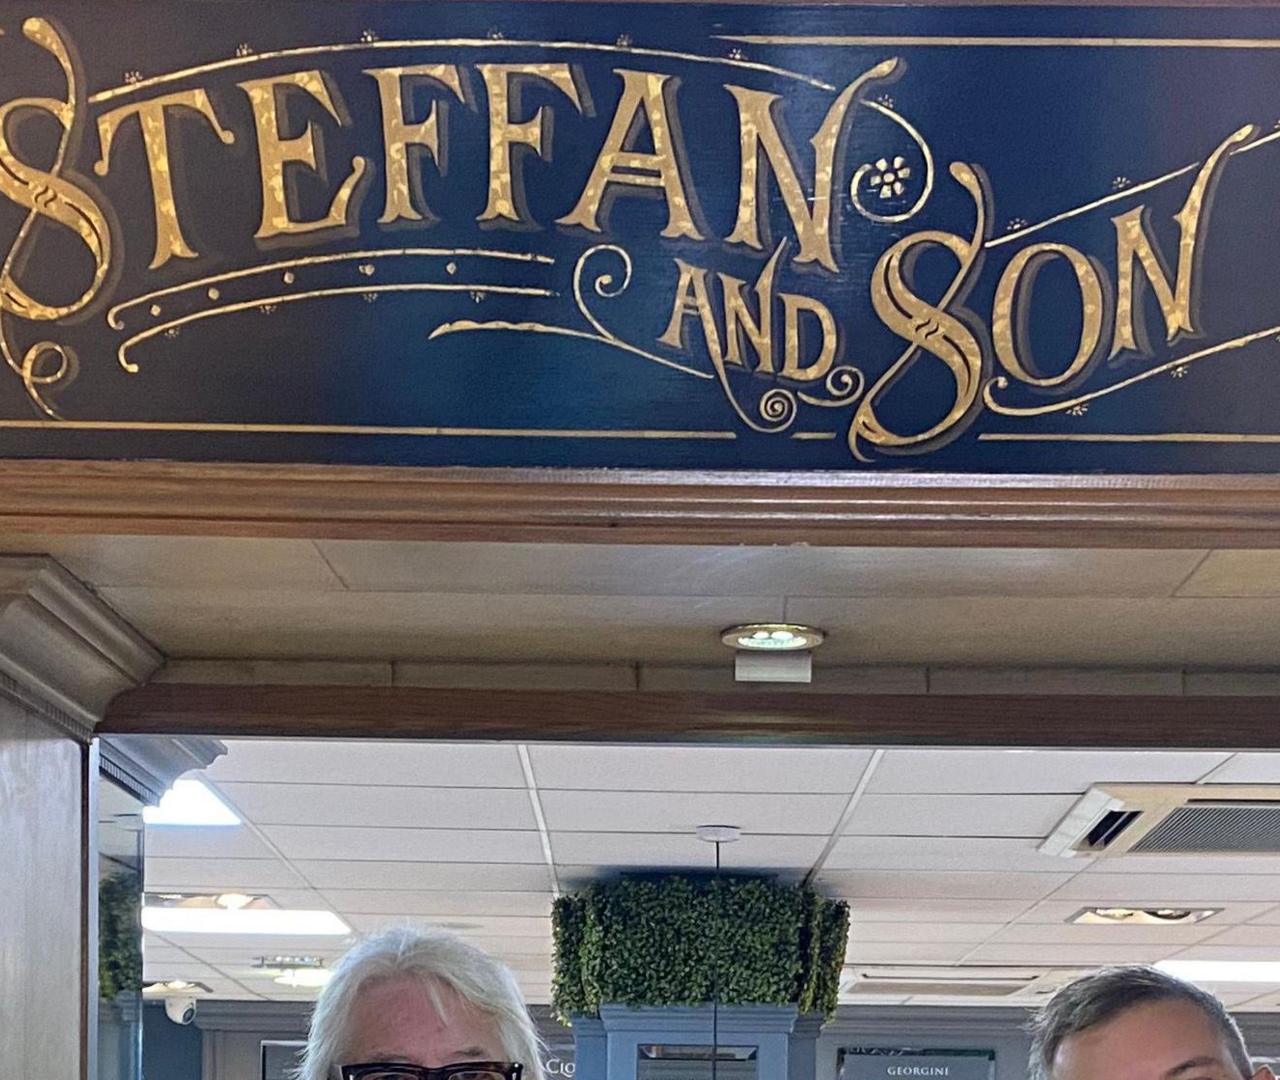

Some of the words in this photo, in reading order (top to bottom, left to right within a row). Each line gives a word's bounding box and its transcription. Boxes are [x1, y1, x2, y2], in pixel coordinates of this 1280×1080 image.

[657, 239, 844, 398] AND
[850, 123, 1260, 462] SON
[887, 1066, 950, 1077] GEORGINI
